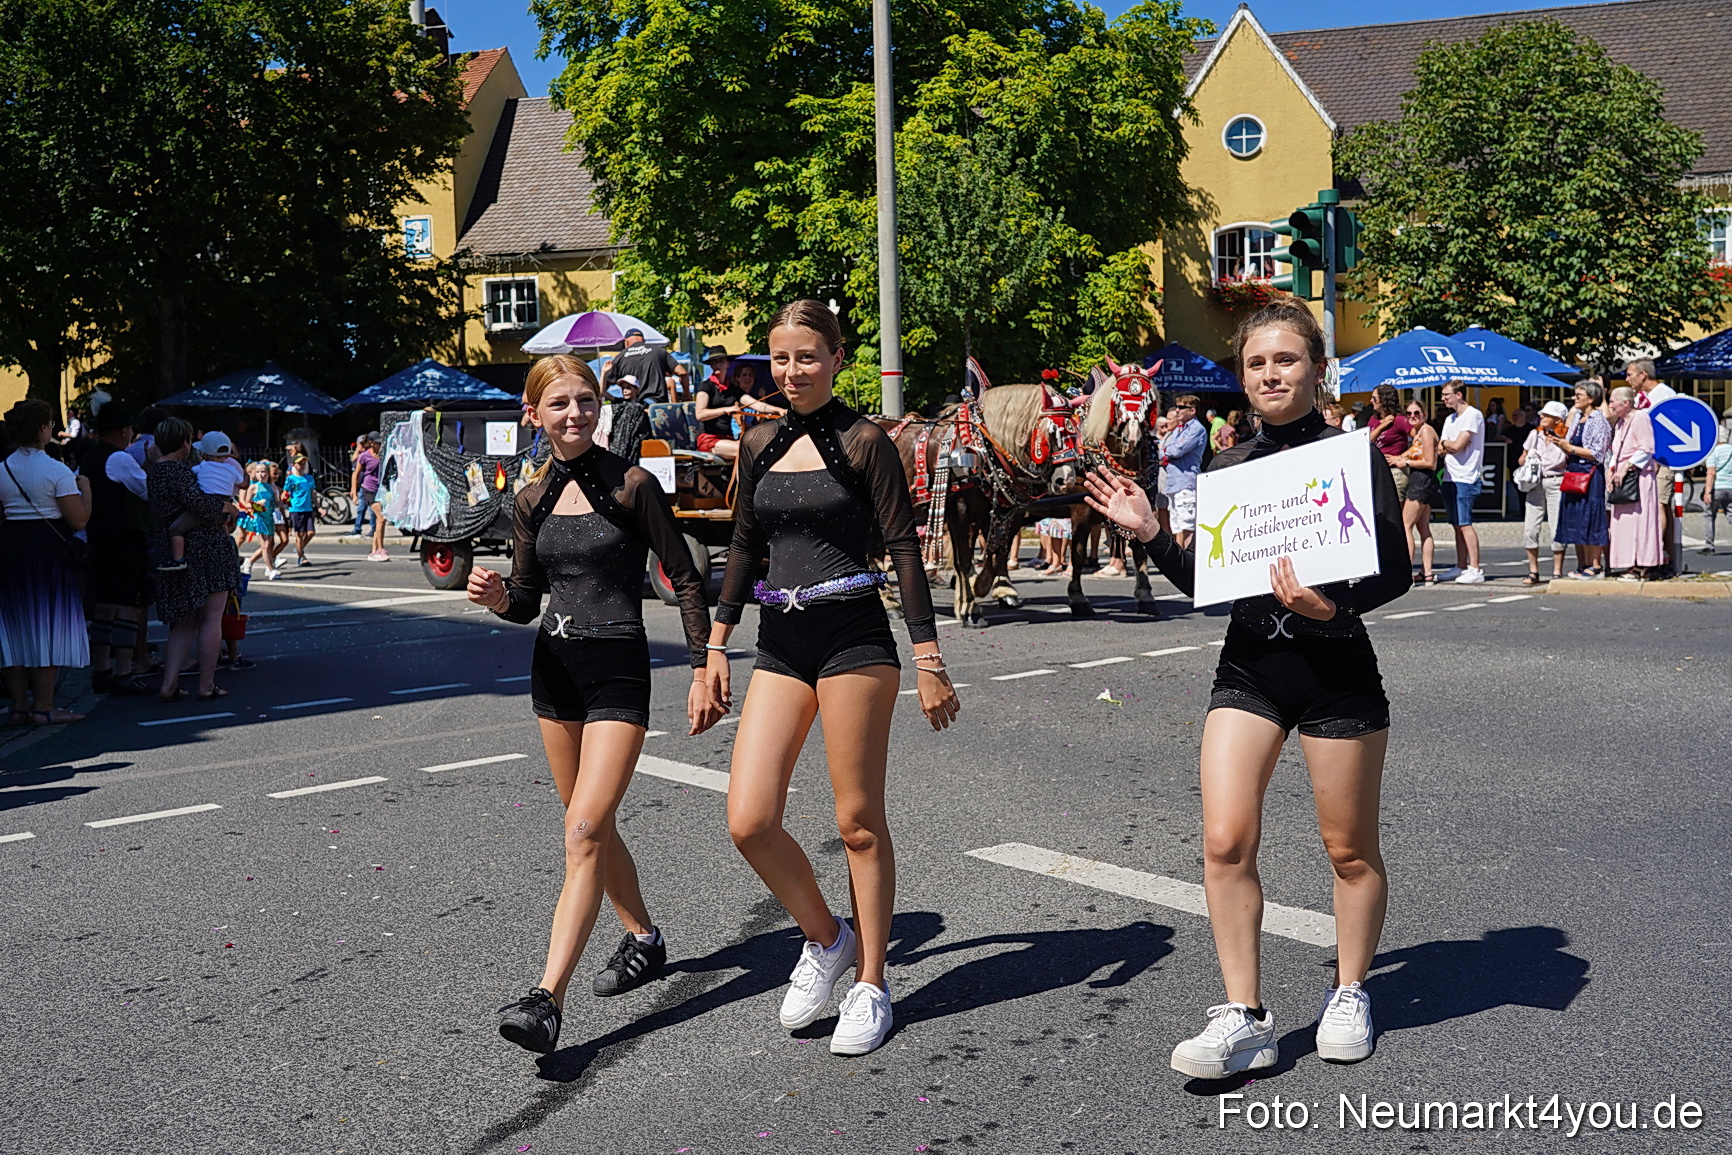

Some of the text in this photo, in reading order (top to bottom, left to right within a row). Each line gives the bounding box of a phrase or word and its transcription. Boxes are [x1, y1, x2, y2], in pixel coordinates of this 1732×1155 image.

[1240, 486, 1309, 520] Turn- und
[1231, 510, 1323, 543] Artistikverein
[1230, 530, 1332, 566] Neumarkt e. V.
